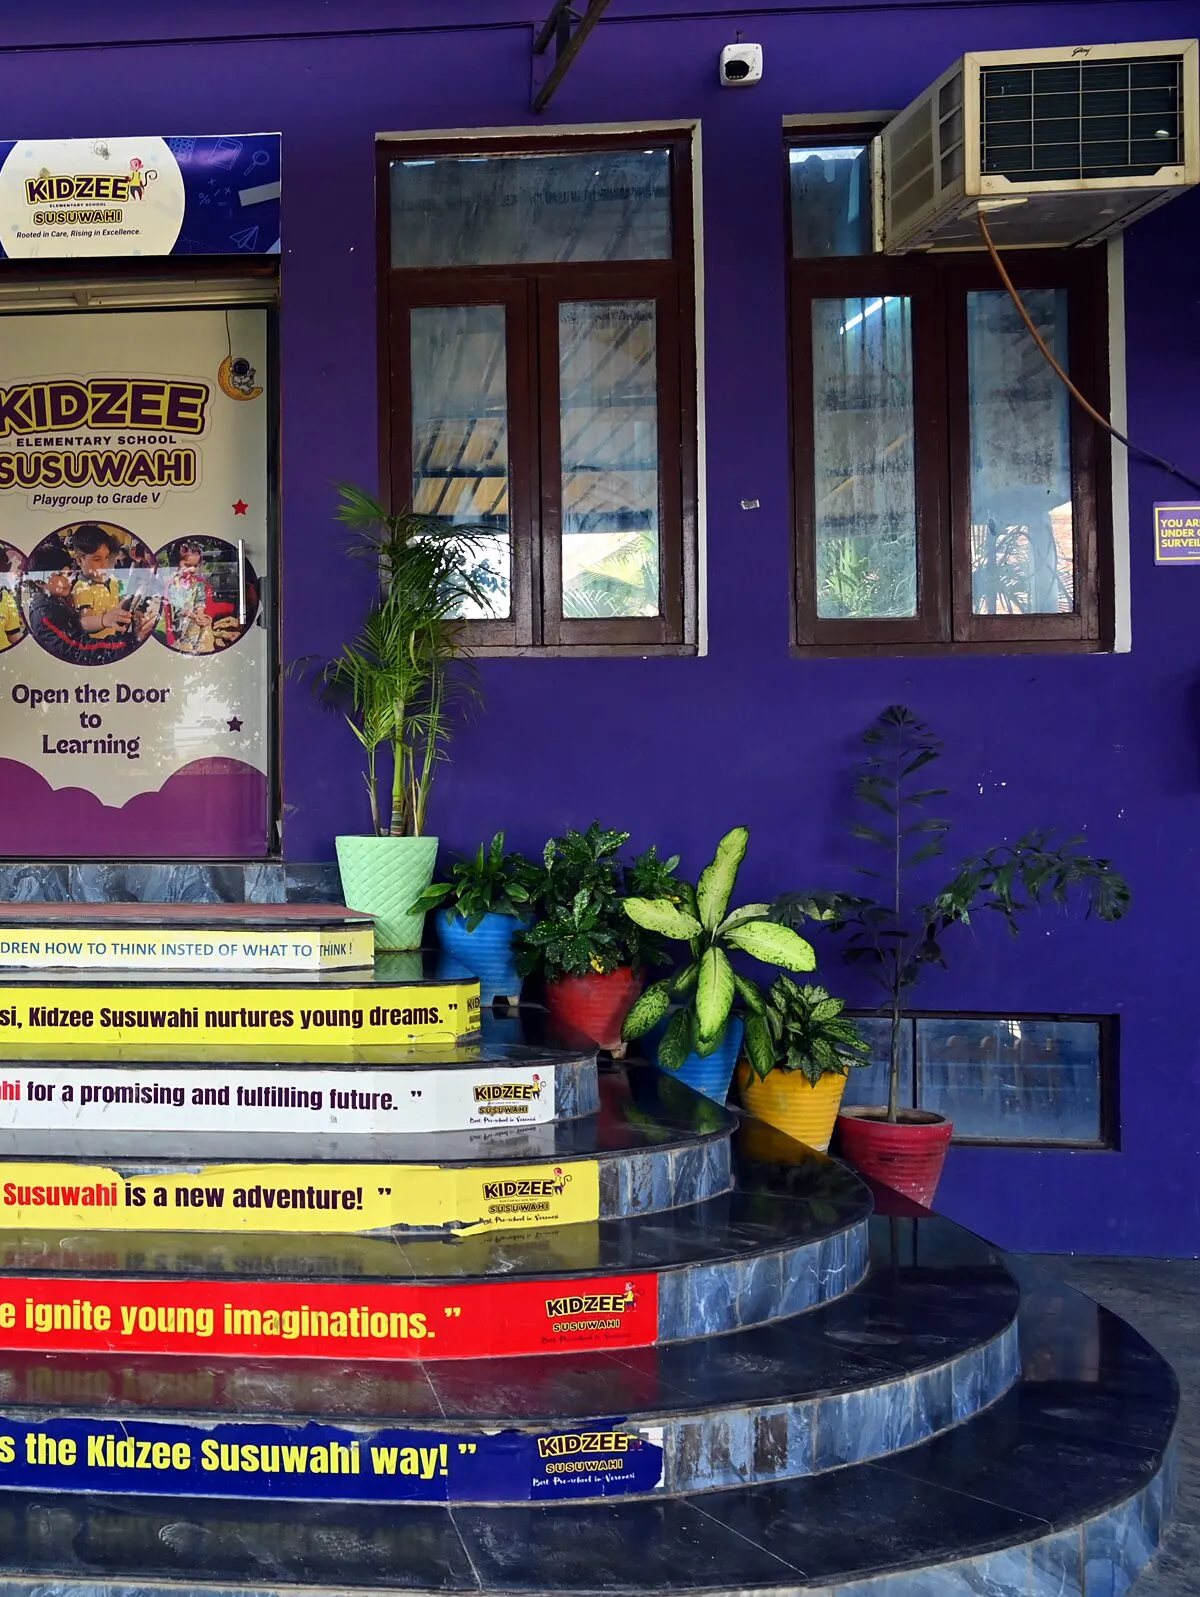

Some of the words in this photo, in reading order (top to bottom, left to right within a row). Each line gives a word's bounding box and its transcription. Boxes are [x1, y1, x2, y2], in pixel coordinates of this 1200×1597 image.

[26, 175, 129, 204] KIDZEE
[33, 209, 122, 225] SUSUWAHI
[16, 231, 41, 239] Rooted
[42, 230, 50, 238] in
[50, 230, 69, 238] Care,
[70, 230, 92, 240] Rising
[102, 228, 141, 236] Excellence.
[16, 436, 112, 447] ELEMENTARY
[118, 435, 177, 446] SCHOOL
[32, 493, 94, 508] Playgroup
[97, 494, 110, 504] to
[112, 493, 149, 504] Grade
[151, 492, 161, 504] V
[1160, 518, 1184, 528] YOU
[1185, 518, 1200, 528] AR
[1160, 528, 1195, 538] UNDER
[11, 684, 69, 708] Open
[75, 684, 110, 704] the
[116, 684, 170, 704] Door
[79, 711, 102, 729] to
[42, 734, 140, 760] Learning
[45, 942, 85, 955] HOW
[87, 942, 108, 956] TO
[111, 942, 158, 956] THINK
[161, 942, 214, 956] INSTED
[218, 943, 238, 956] OF
[242, 944, 288, 957] WHAT
[292, 944, 313, 957] TO
[317, 943, 347, 958] THINK
[28, 1006, 94, 1028] Kidzee
[99, 1007, 199, 1028] Susuwahi
[205, 1007, 295, 1028] nurtures
[299, 1009, 364, 1030] young
[370, 1006, 443, 1025] dreams.
[26, 1080, 56, 1102] for
[61, 1084, 74, 1103] a
[80, 1082, 185, 1107] promising
[191, 1085, 230, 1106] and
[236, 1085, 323, 1111] fulfilling
[329, 1088, 399, 1111] future.
[473, 1084, 532, 1102] KIDZEE
[478, 1105, 529, 1114] SUSUWAHI
[3, 1182, 118, 1207] Susuwahi
[125, 1183, 146, 1206] is
[153, 1186, 168, 1207] a
[175, 1187, 225, 1208] new
[232, 1184, 363, 1211] adventure!
[483, 1180, 553, 1200] KIDZEE
[488, 1201, 550, 1214] SUSUWAHI
[546, 1295, 624, 1317] KIDZEE
[25, 1297, 111, 1333] ignite
[120, 1305, 214, 1337] young
[224, 1303, 436, 1340] imaginations.
[552, 1319, 620, 1332] SUSUWAHI
[538, 1432, 628, 1458] KIDZEE
[26, 1432, 77, 1466] the
[88, 1435, 191, 1470] Kidzee
[201, 1440, 360, 1474] Susuwahi
[372, 1443, 448, 1480] way!
[546, 1458, 624, 1474] SUSUWAHI
